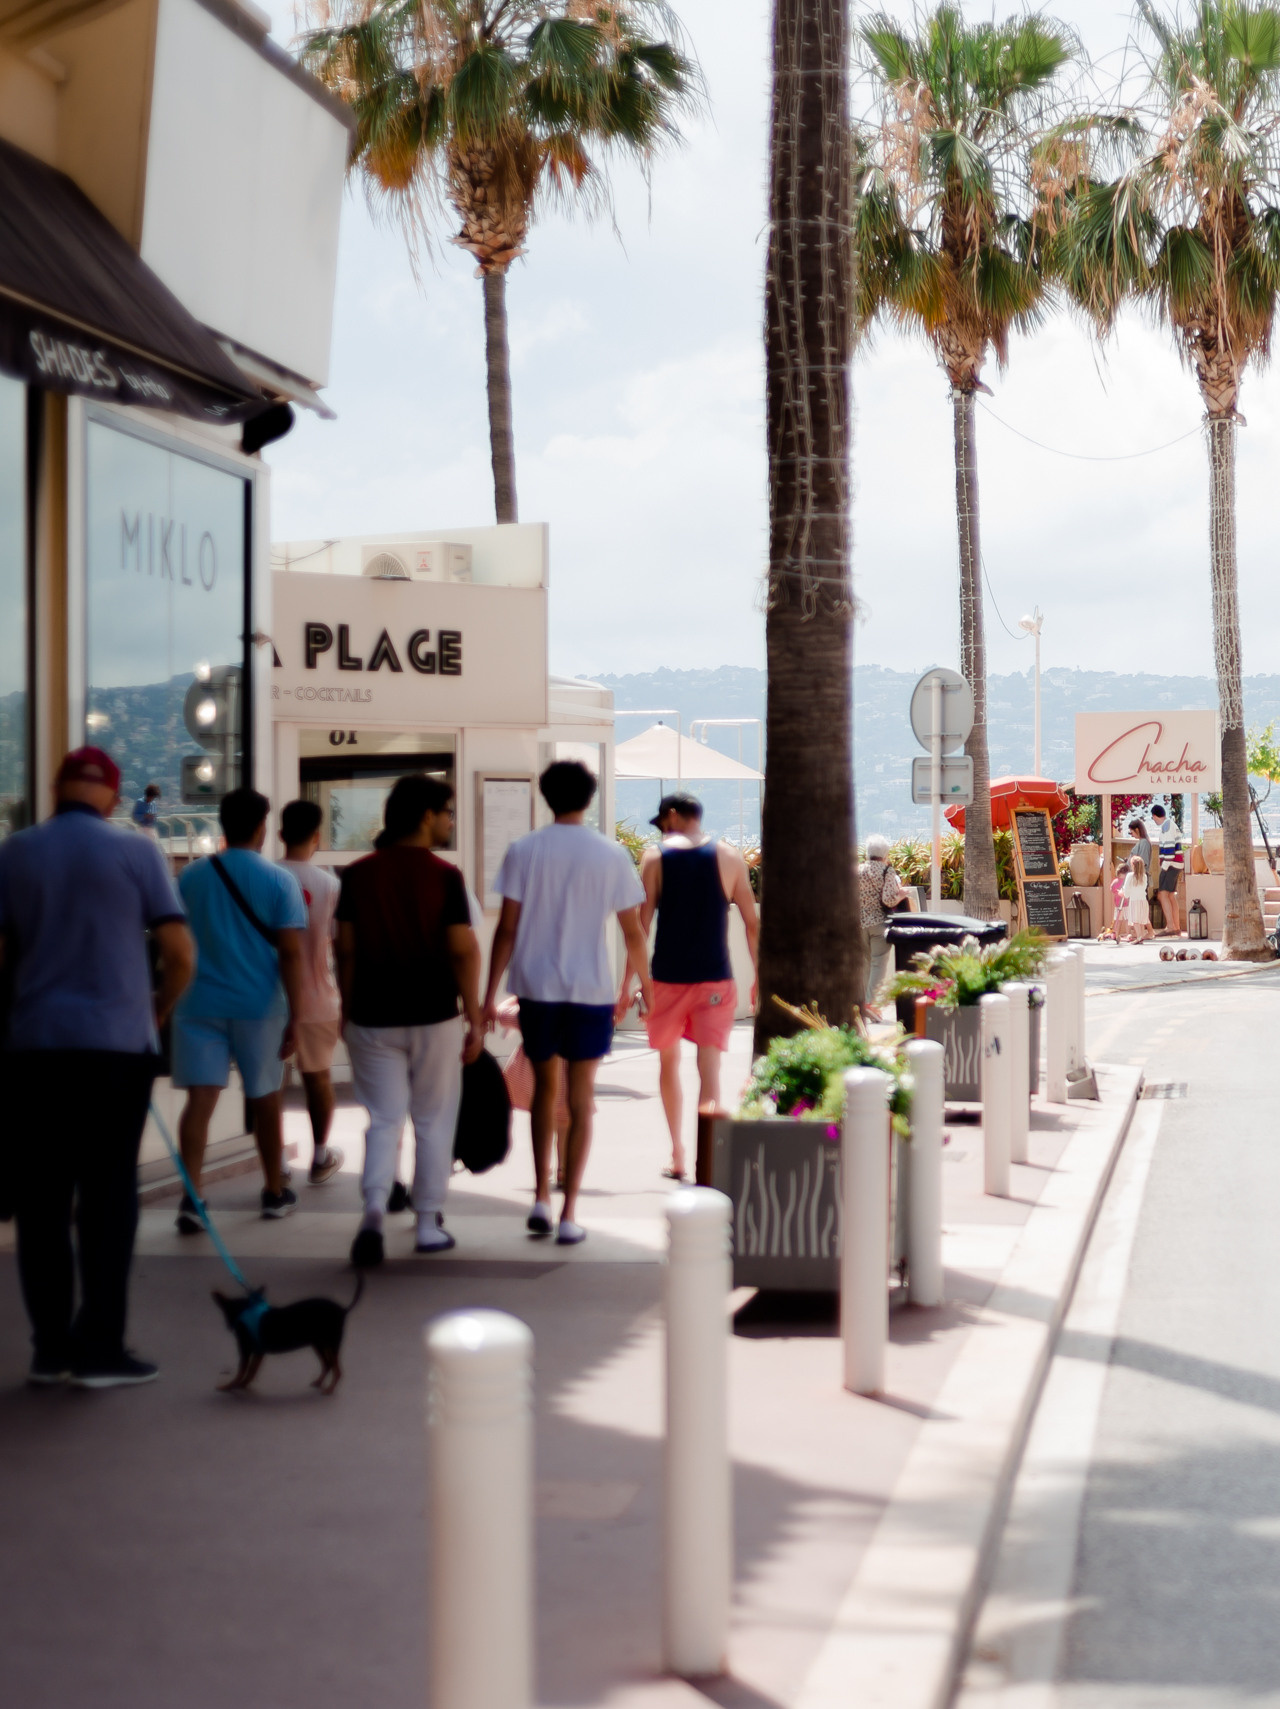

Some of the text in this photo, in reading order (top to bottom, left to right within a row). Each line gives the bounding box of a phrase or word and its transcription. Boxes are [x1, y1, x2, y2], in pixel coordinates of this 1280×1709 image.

[29, 331, 119, 388] SHADES
[120, 508, 217, 592] MIKLO
[304, 621, 462, 676] PLAGE
[294, 686, 372, 703] COCKTAILS
[1087, 721, 1207, 784] Chacha
[1150, 775, 1198, 784] LA PLAGE
